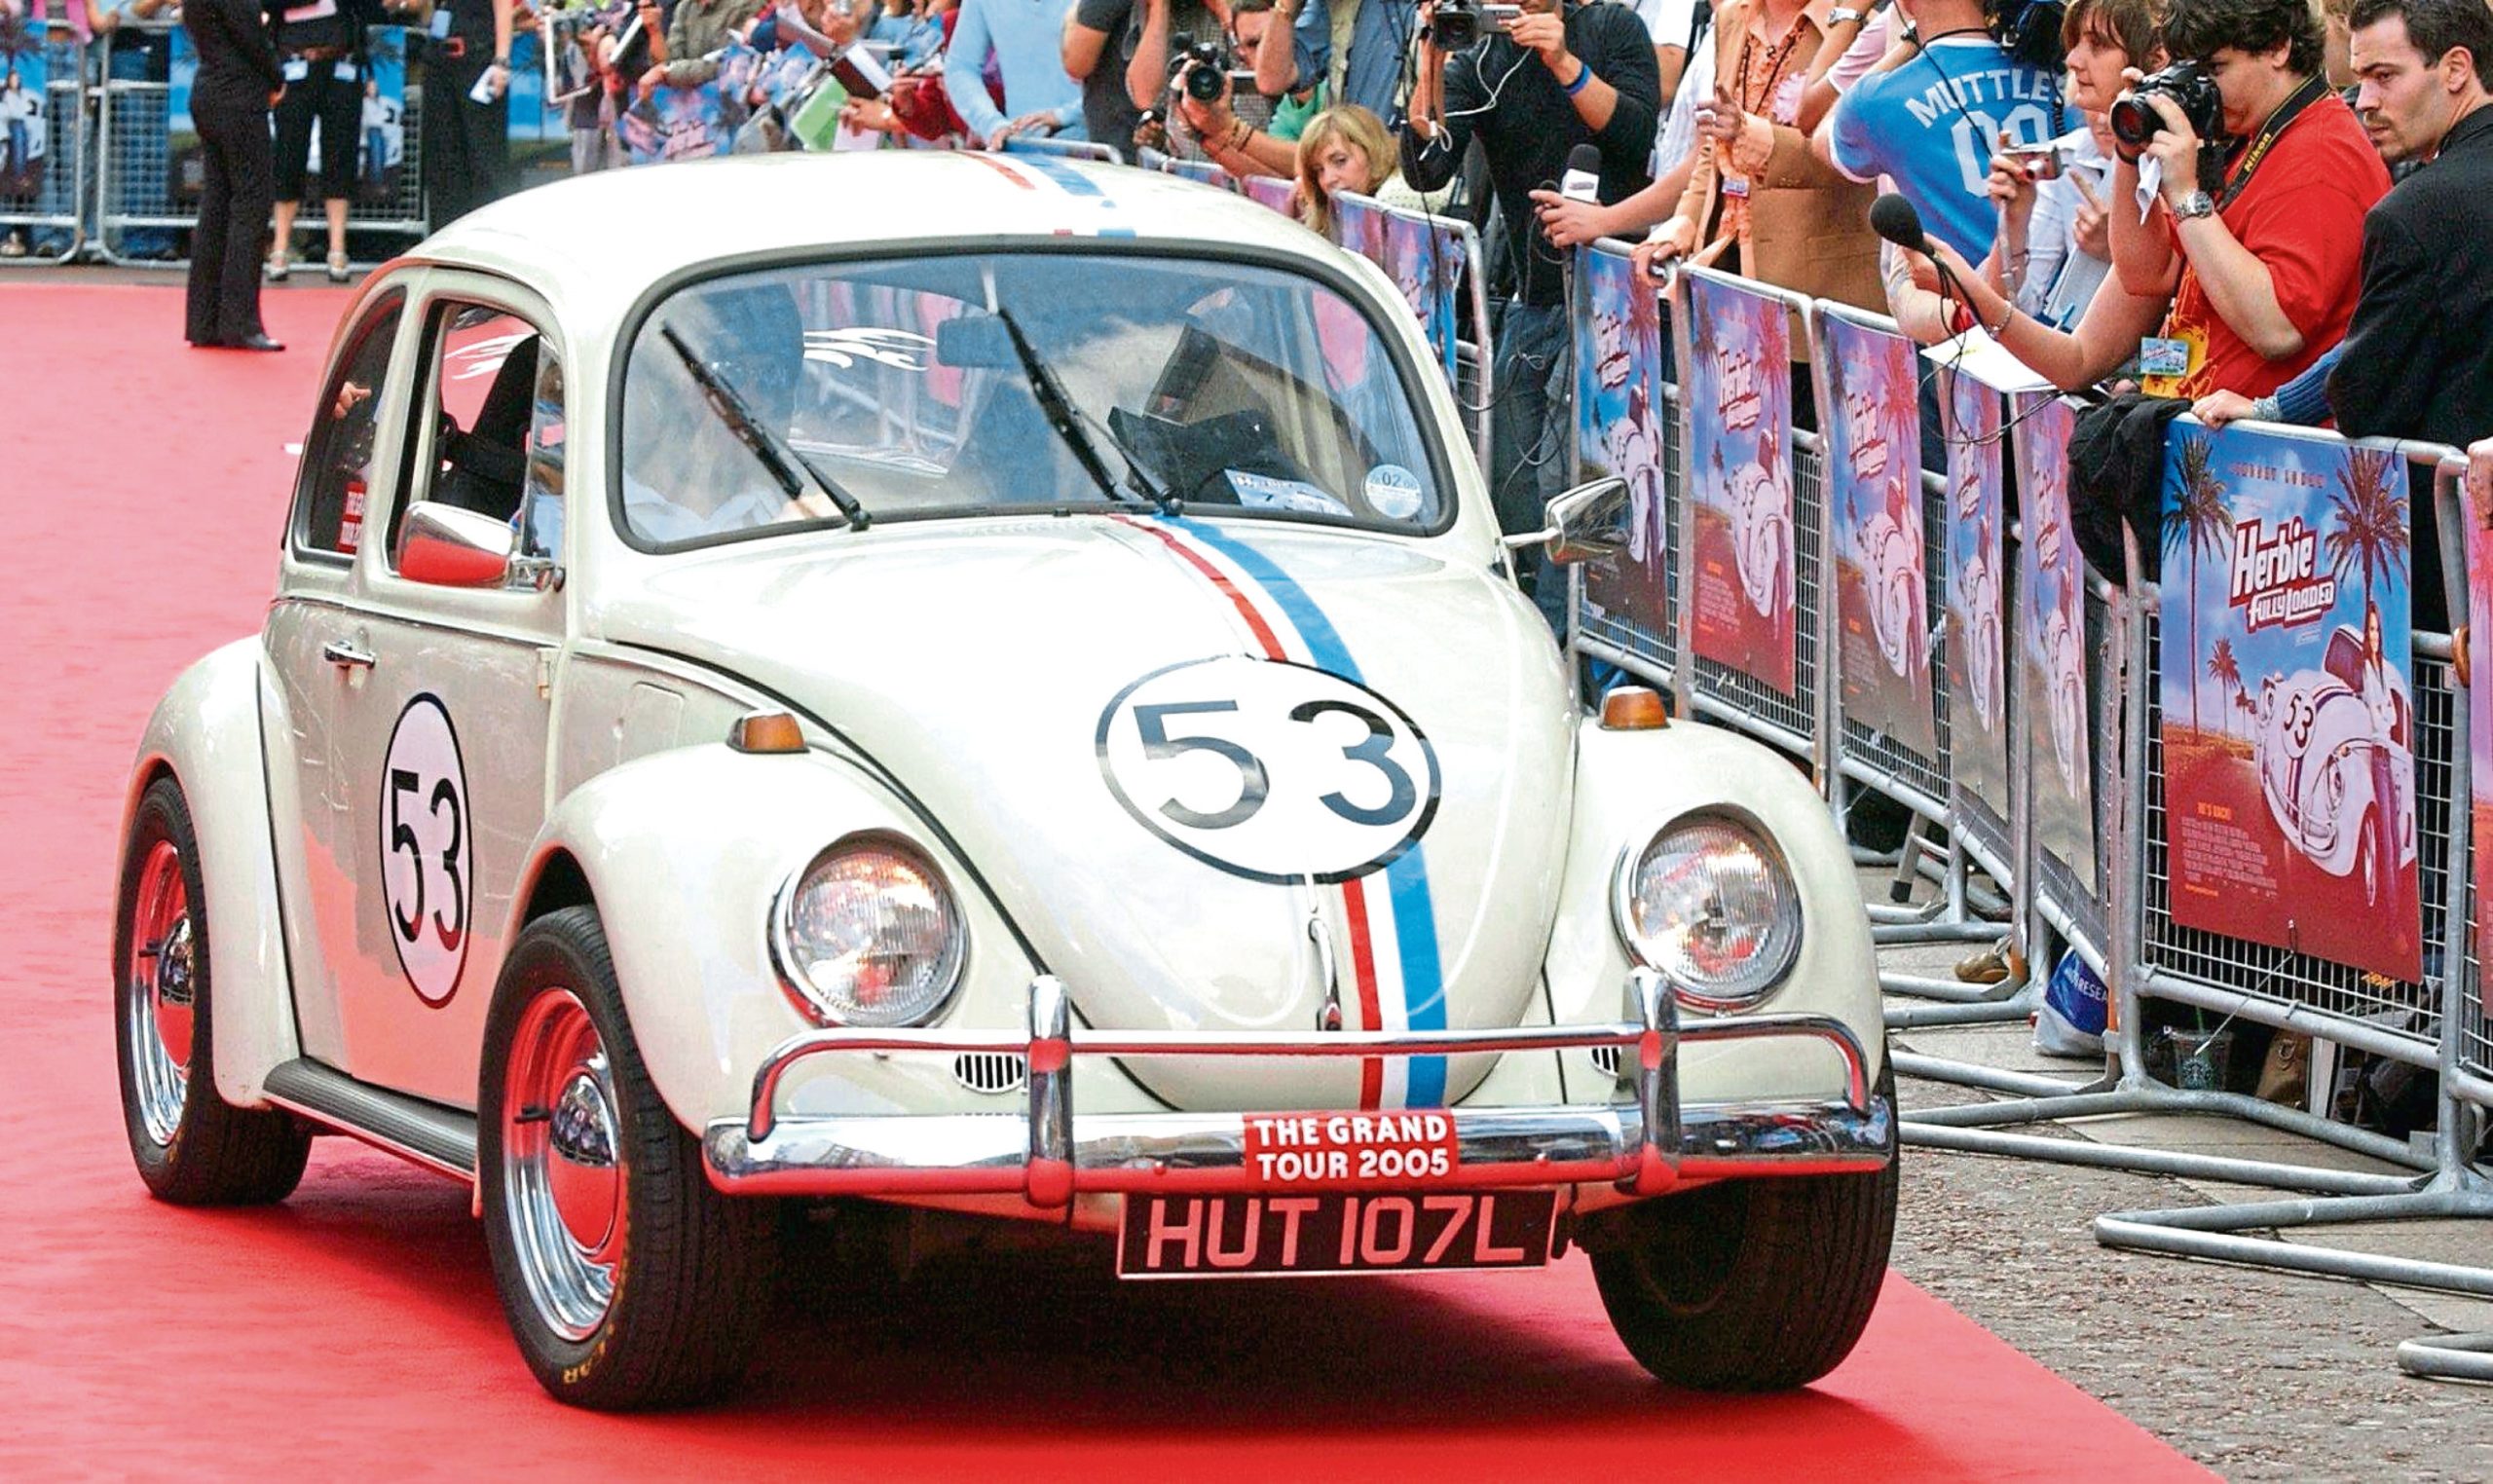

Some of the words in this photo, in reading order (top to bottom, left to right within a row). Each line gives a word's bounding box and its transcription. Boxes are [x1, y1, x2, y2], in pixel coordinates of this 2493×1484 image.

[2244, 132, 2272, 172] Nikon
[1382, 471, 1401, 487] 02
[2231, 516, 2315, 599] Herbie
[2249, 588, 2286, 628] FULLY
[2283, 692, 2314, 749] 53
[1133, 699, 1417, 830] 53
[391, 767, 463, 951] 53
[1252, 1120, 1318, 1146] THE
[1326, 1116, 1448, 1143] GRAND
[1256, 1152, 1349, 1181] TOUR
[1358, 1148, 1450, 1177] 2005
[1146, 1198, 1319, 1267] HUT
